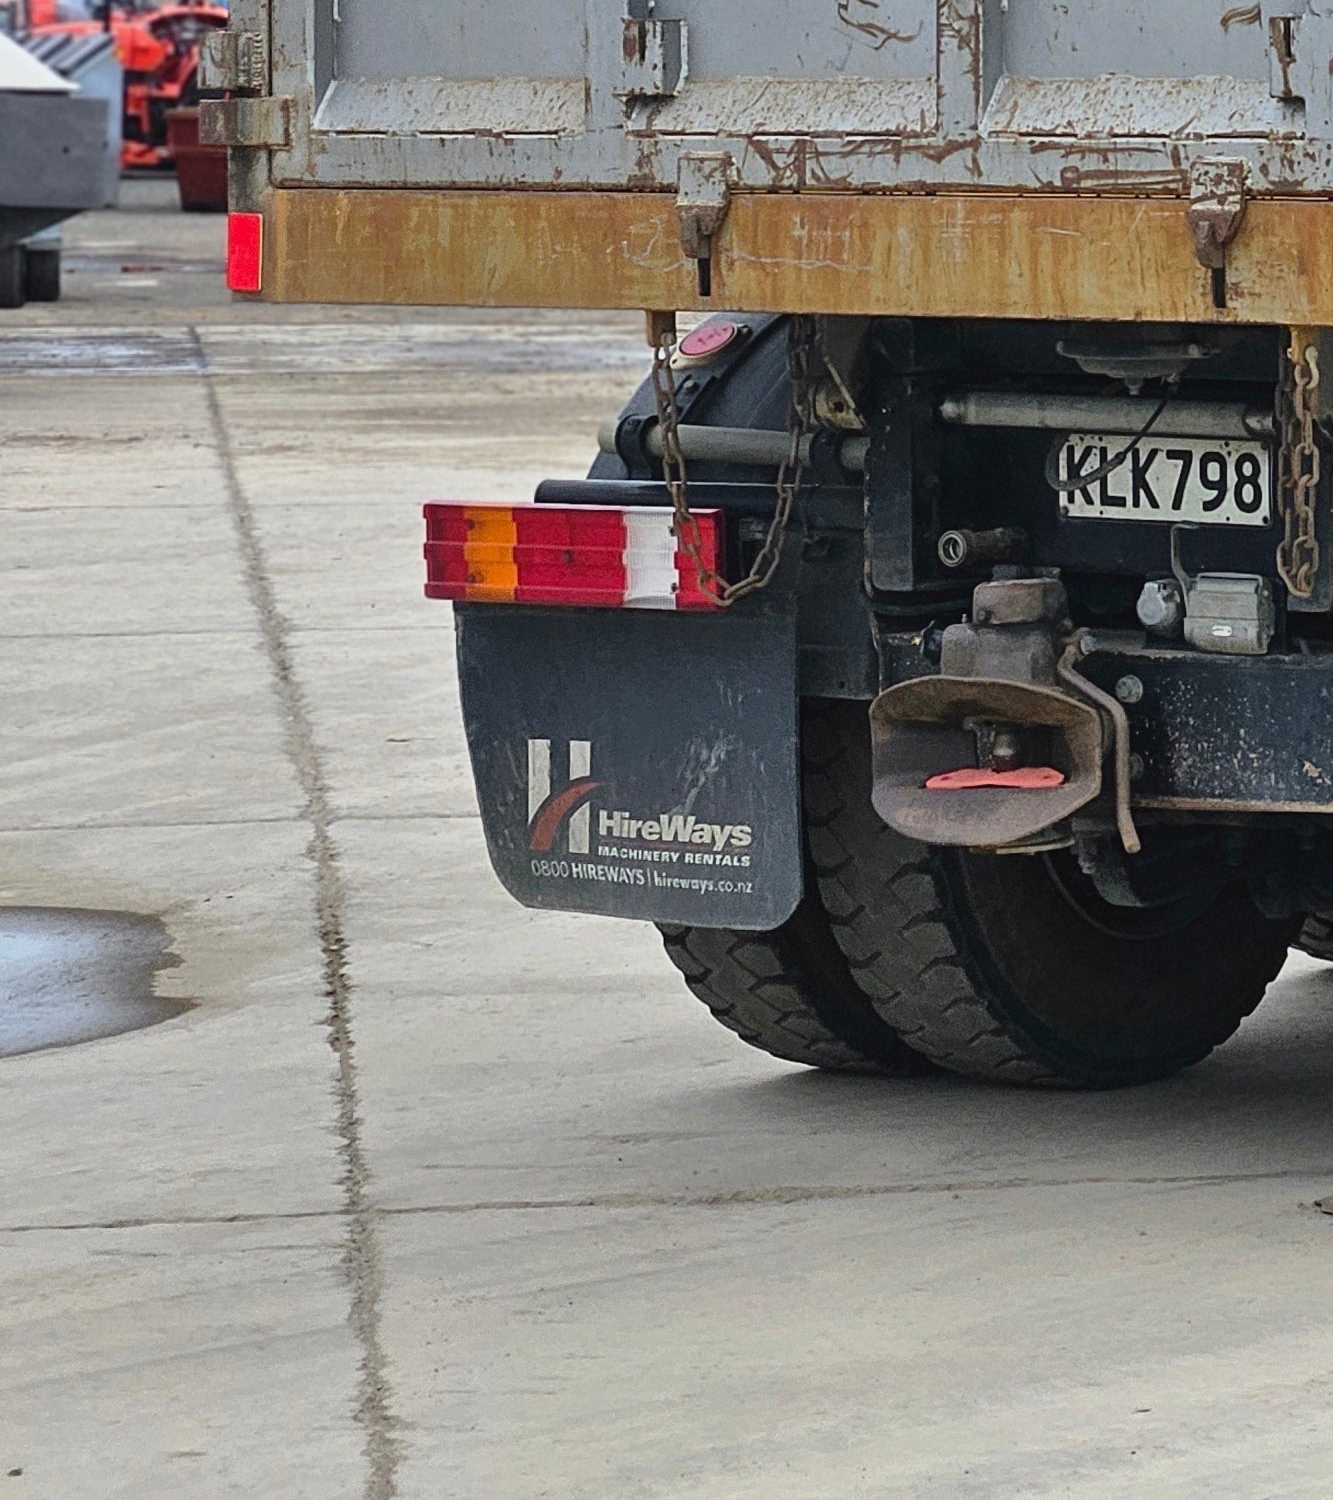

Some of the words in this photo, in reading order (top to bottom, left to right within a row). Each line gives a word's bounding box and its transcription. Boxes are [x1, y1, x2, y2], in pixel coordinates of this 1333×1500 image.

[1066, 444, 1263, 514] KLK798
[599, 809, 752, 851] HireWays
[598, 845, 679, 863] MACHINERY
[684, 852, 751, 867] RENTALS
[531, 859, 569, 878] 0800
[571, 862, 645, 886] HIREWAYS
[653, 871, 753, 895] hireways.co.nz
